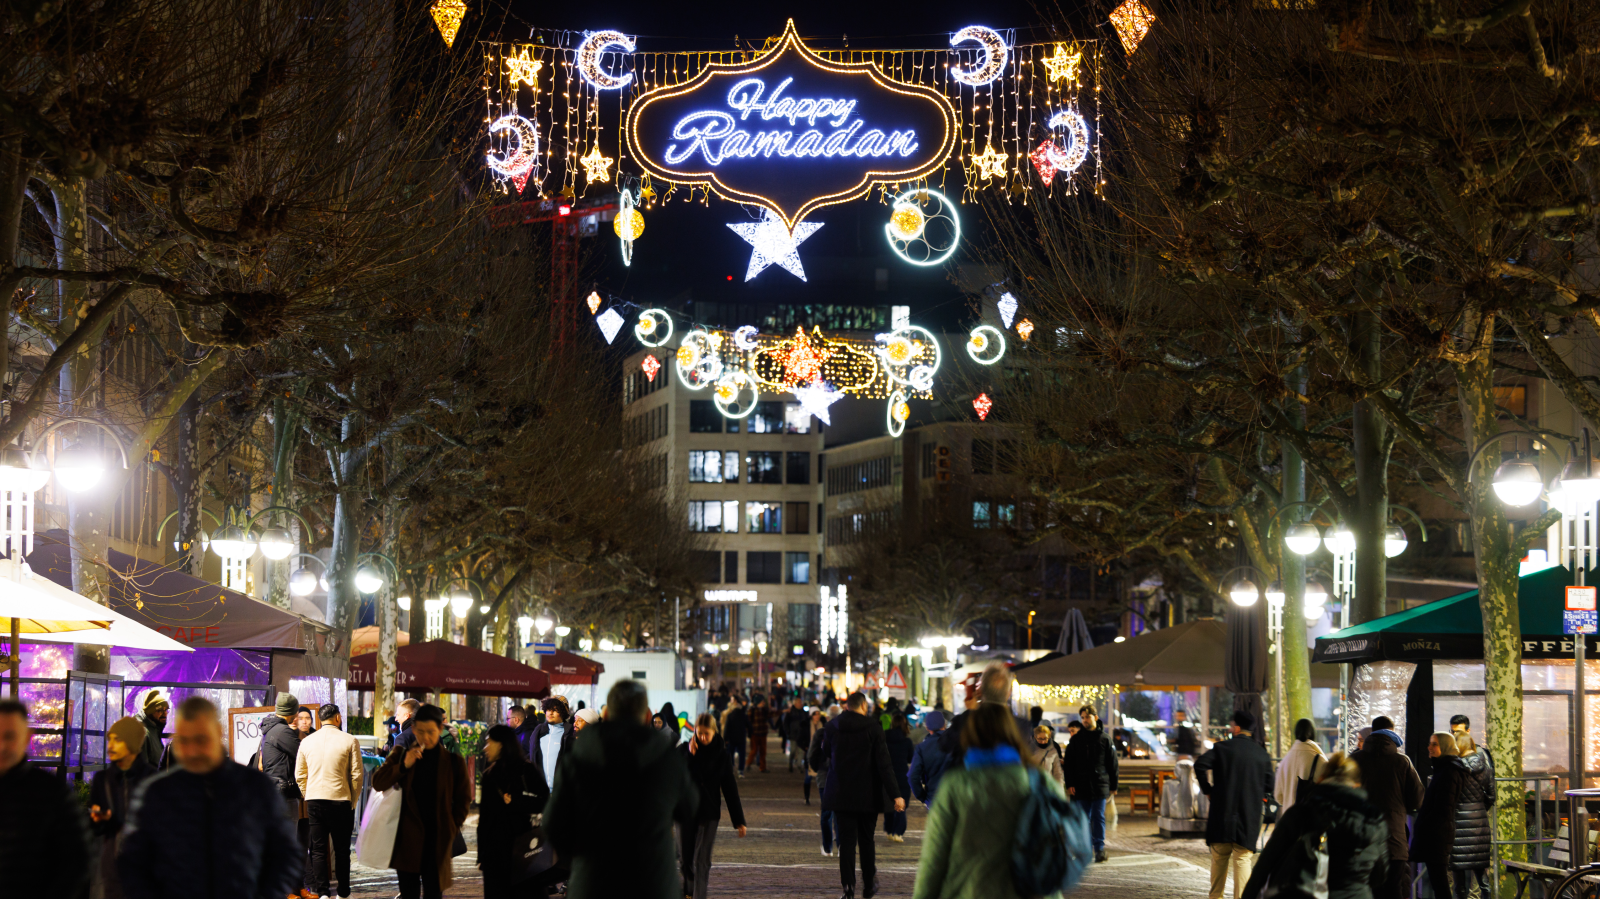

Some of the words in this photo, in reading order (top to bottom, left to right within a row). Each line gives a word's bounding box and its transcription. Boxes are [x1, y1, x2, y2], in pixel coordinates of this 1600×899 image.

[728, 77, 857, 126] Happy
[664, 110, 919, 165] Ramadan
[704, 590, 758, 601] WEMPE
[348, 670, 363, 683] RET
